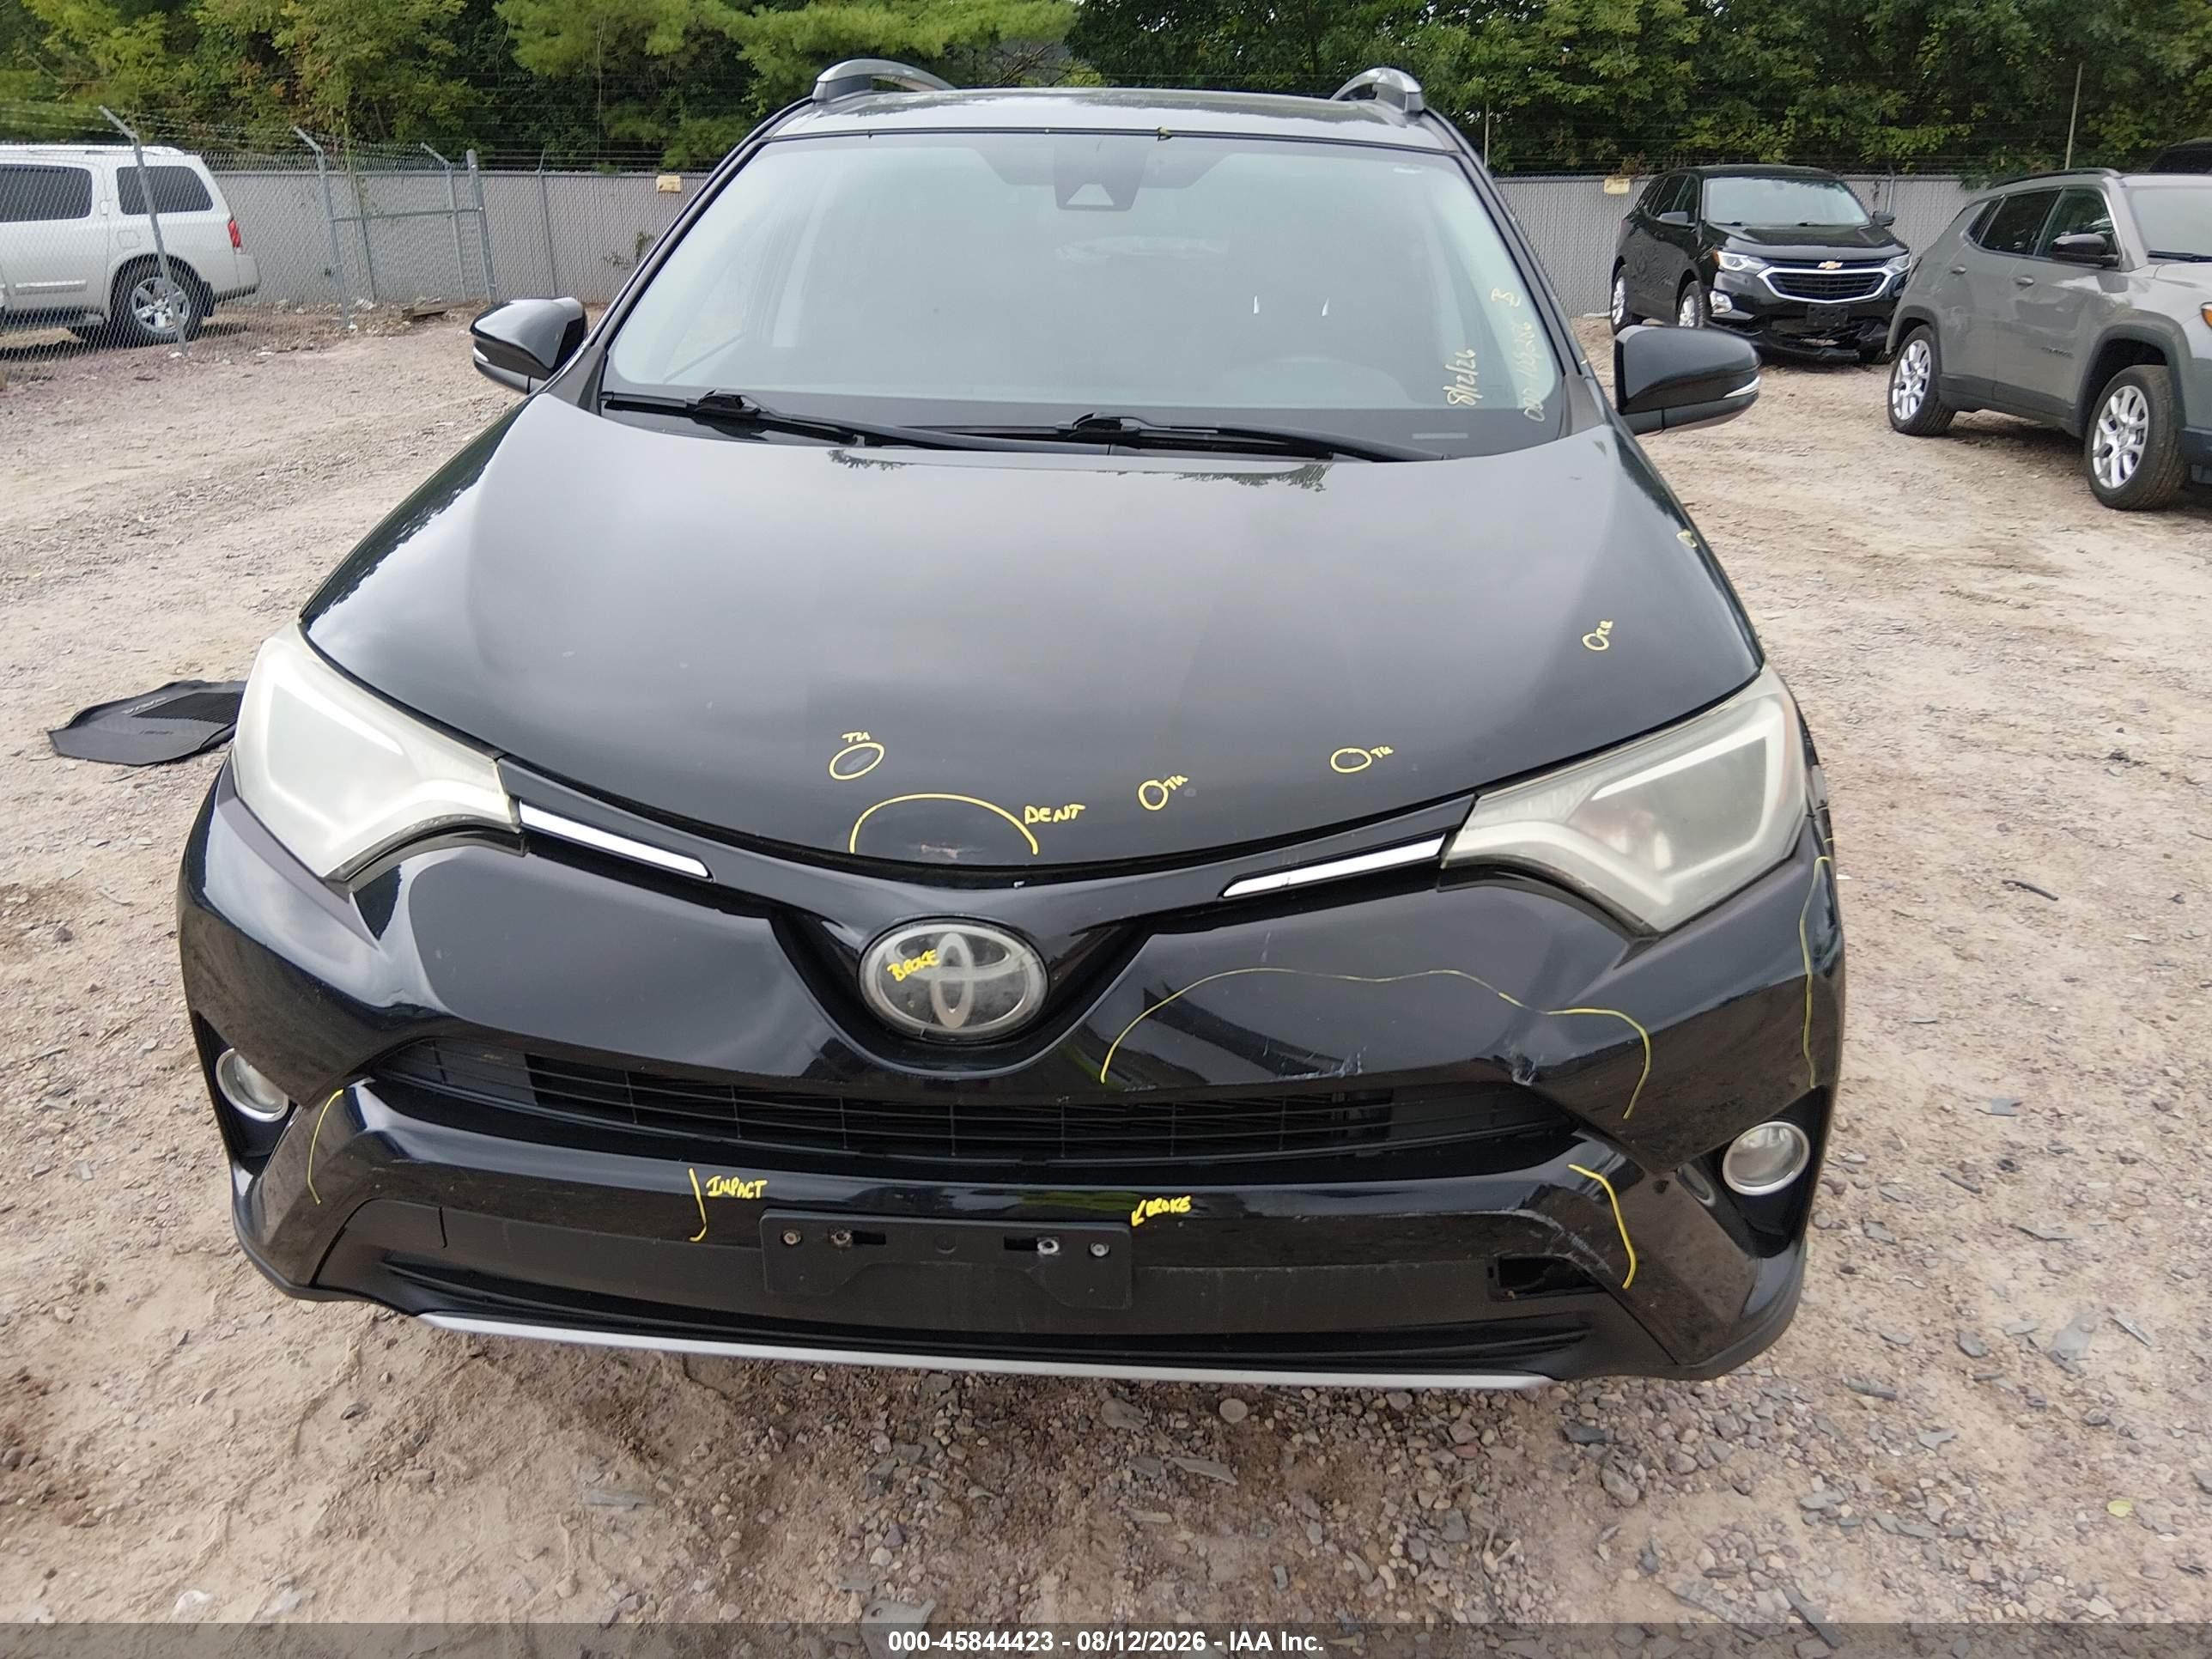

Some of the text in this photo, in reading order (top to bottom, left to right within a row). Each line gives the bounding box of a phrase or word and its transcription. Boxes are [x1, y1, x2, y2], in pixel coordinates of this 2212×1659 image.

[1443, 348, 1483, 406] 8/12/26
[1024, 804, 1086, 824] DENT
[706, 1176, 768, 1200] IMPACT
[1146, 1195, 1191, 1217] BROKE
